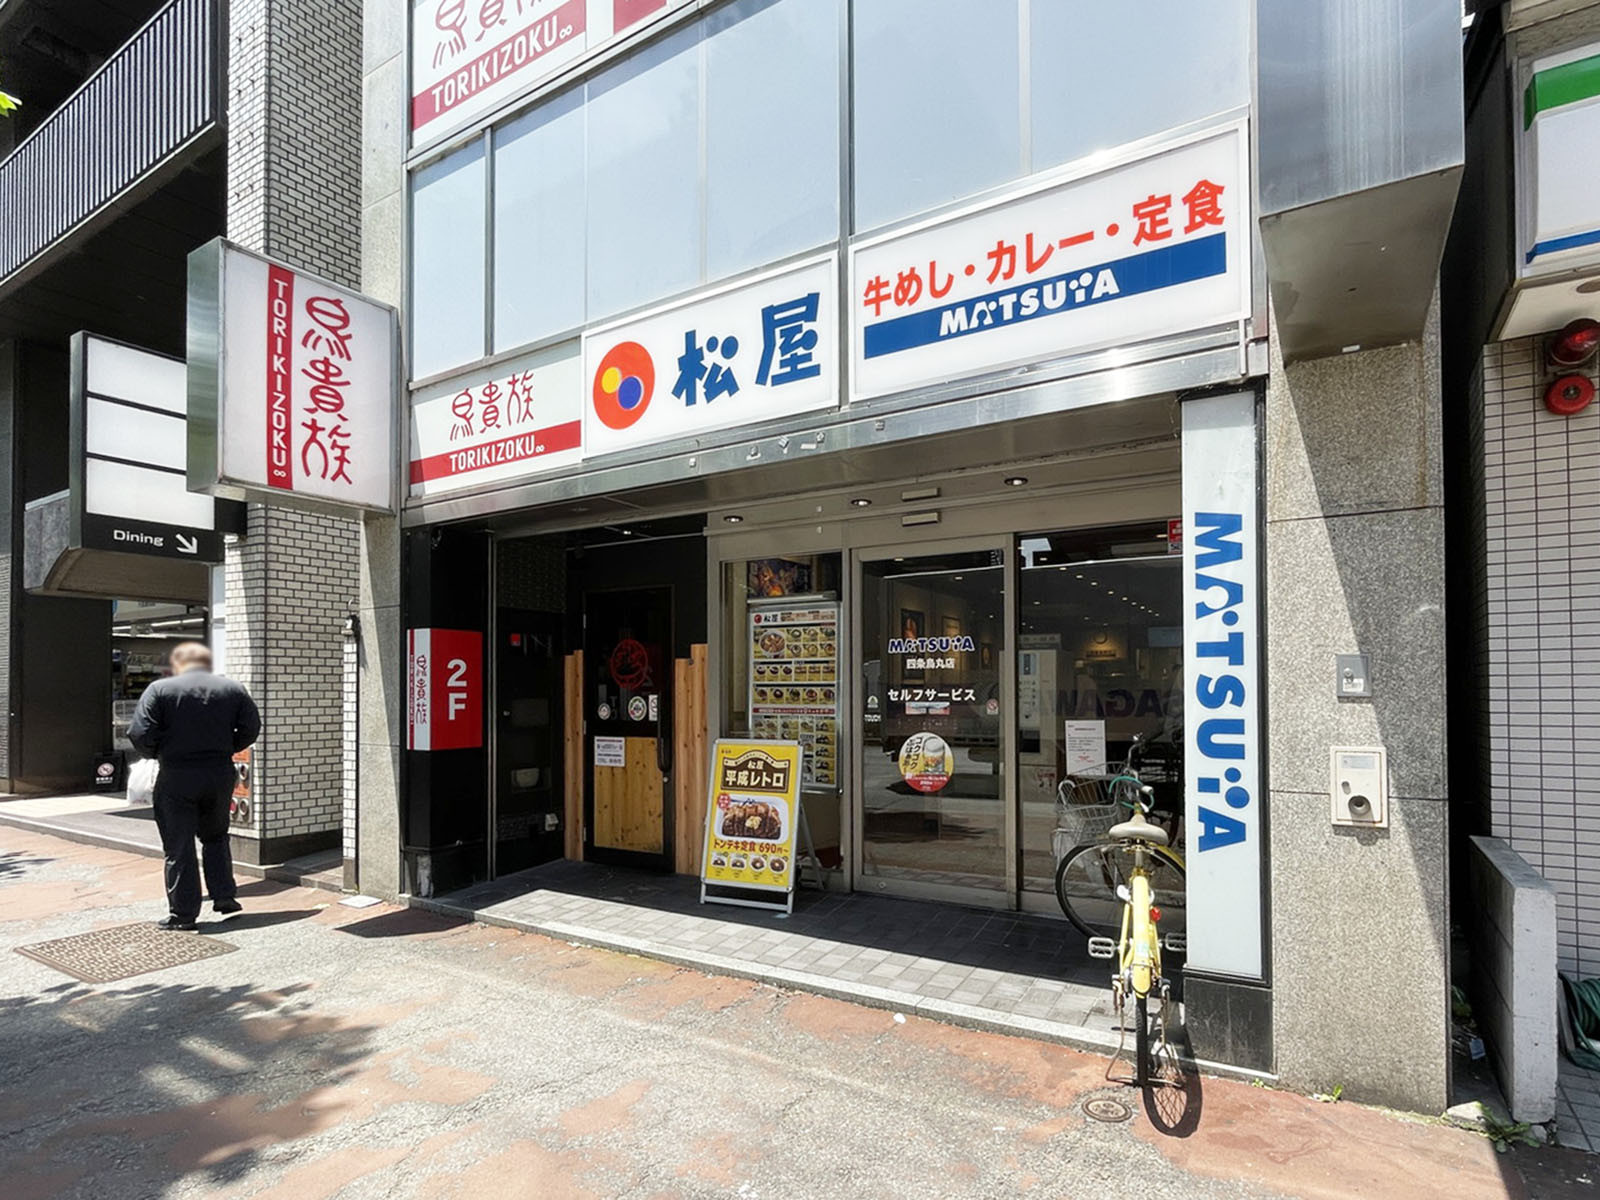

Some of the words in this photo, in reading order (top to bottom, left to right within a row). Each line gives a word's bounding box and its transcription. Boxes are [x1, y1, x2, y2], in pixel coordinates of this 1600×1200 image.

[938, 268, 1120, 336] MATSUYA
[671, 292, 821, 407] 松屋
[113, 529, 165, 548] Dining
[888, 635, 975, 654] MATSUYA
[446, 658, 468, 721] 2F
[887, 688, 976, 701] セルフサービス
[1194, 511, 1251, 853] MATSUYA
[725, 769, 785, 787] 平成レトロ
